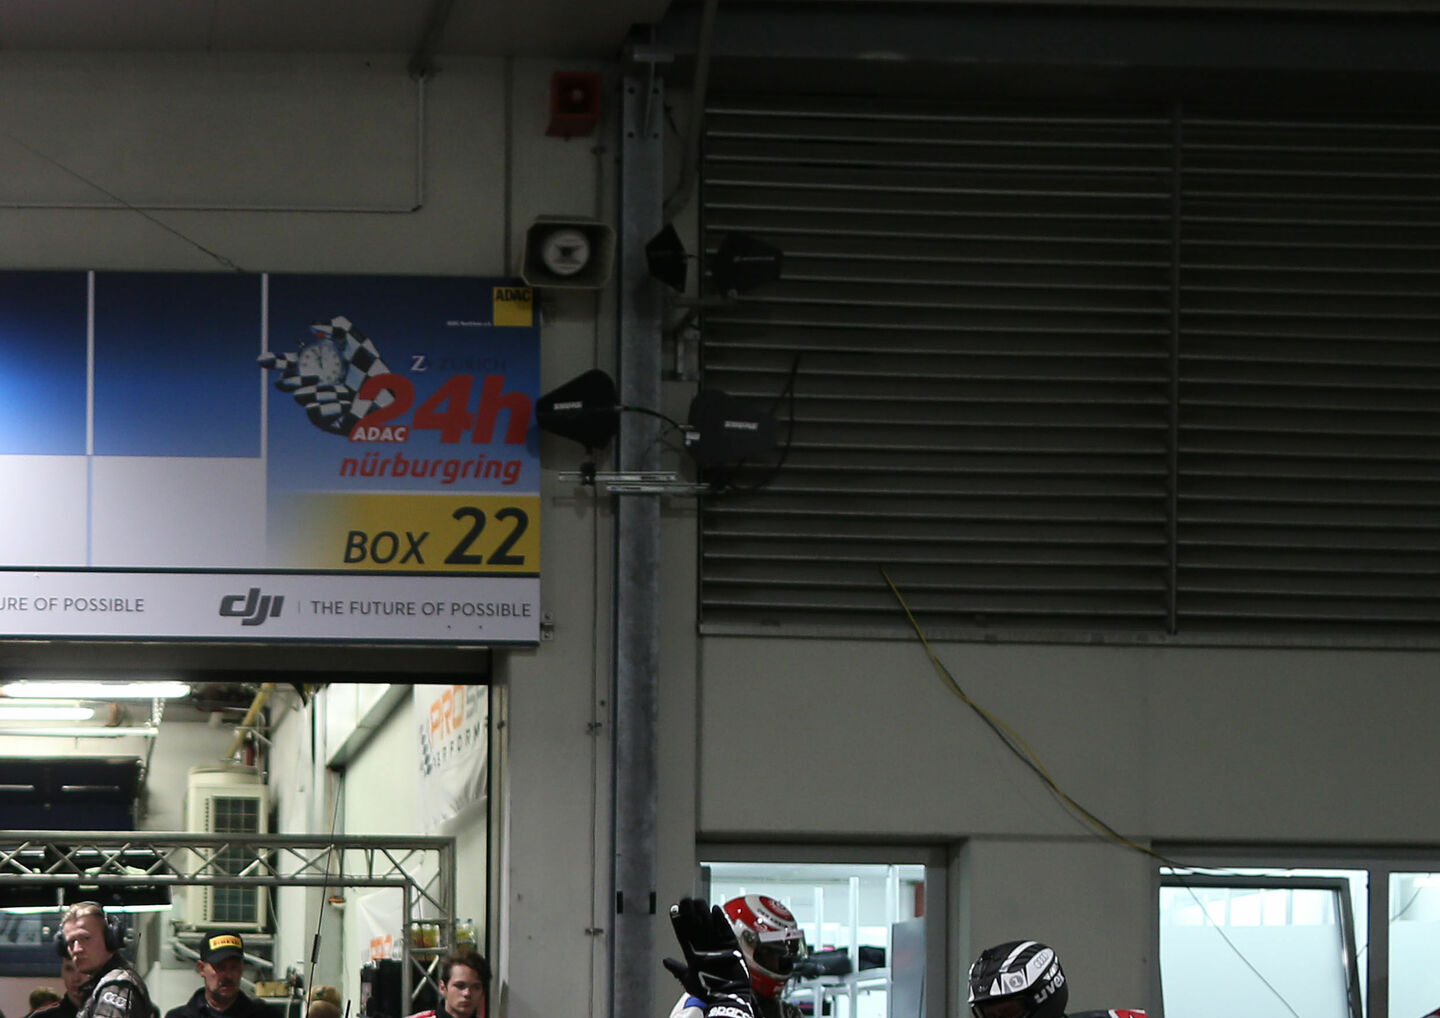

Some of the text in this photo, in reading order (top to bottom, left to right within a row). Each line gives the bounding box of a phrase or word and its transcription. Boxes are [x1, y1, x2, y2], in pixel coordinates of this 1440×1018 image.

[355, 372, 533, 445] 24h
[353, 426, 407, 442] ADAC
[339, 452, 523, 485] nürburgring
[343, 505, 530, 566] BOX 22
[34, 597, 59, 612] OF
[63, 597, 145, 612] POSSIBLE
[311, 600, 532, 617] THE FUTURE OF POSSIBLE
